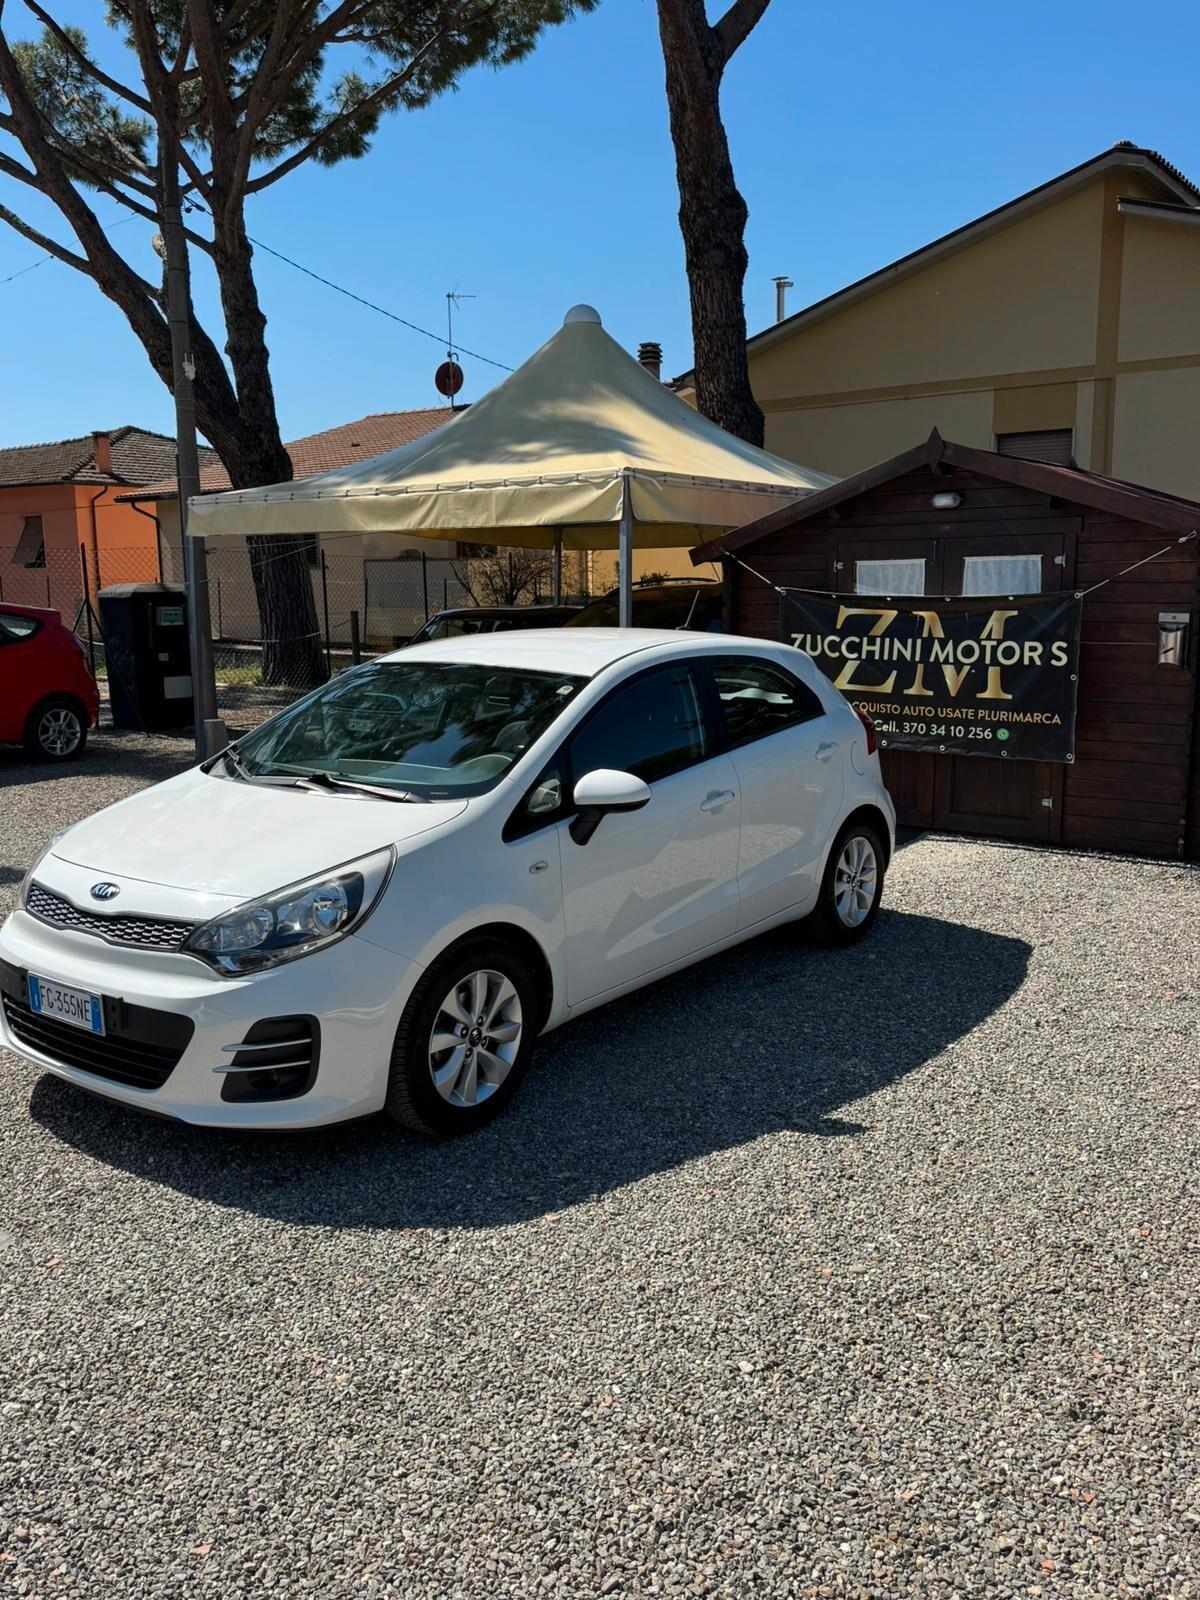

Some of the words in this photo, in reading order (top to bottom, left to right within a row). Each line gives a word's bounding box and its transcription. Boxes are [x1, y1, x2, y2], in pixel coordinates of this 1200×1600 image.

[790, 633, 922, 662] ZUCCHINI
[902, 705, 935, 717] AUTO
[937, 707, 975, 720] USATE
[977, 709, 1062, 725] PLURIMARCA
[874, 719, 900, 733] Cell.
[902, 722, 927, 735] 370
[929, 724, 946, 737] 34
[950, 725, 965, 738] 10
[967, 726, 993, 740] 256
[91, 883, 117, 898] KIA
